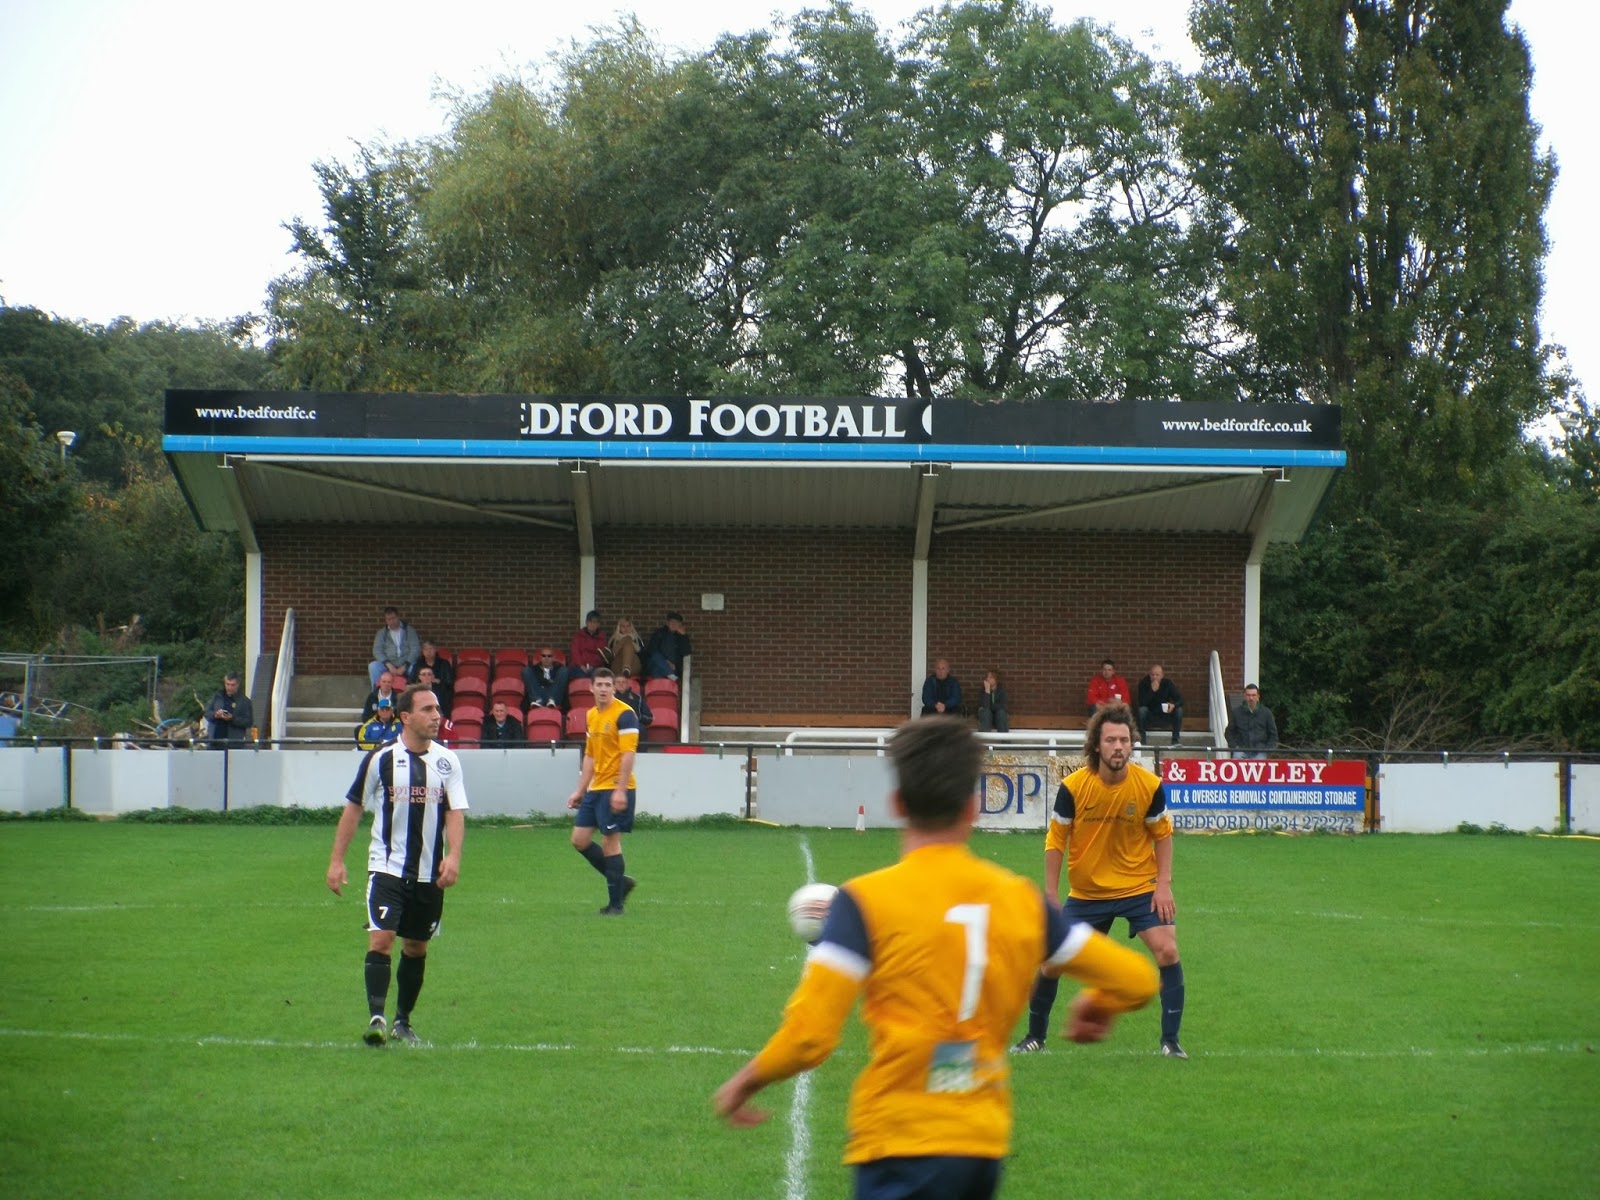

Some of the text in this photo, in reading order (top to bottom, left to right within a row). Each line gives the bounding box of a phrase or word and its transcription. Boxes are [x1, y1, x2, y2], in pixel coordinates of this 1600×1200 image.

[195, 406, 317, 420] www.bedfordfc.c
[688, 399, 906, 438] FOOTBALL
[1161, 418, 1313, 433] www.bedfordfc.co.uk
[1168, 761, 1187, 782] &
[1198, 760, 1327, 784] ROWLEY
[1170, 789, 1181, 804] UK
[1183, 789, 1190, 804] &
[1192, 789, 1228, 804] OVERSEAS
[1229, 789, 1267, 805] REMOVALS
[1268, 790, 1323, 806] CONTAINERISED
[1324, 790, 1357, 806] STORAGE
[1172, 814, 1355, 833] BEDFORD 01234 272272
[378, 906, 388, 920] 7
[943, 903, 991, 1022] 1
